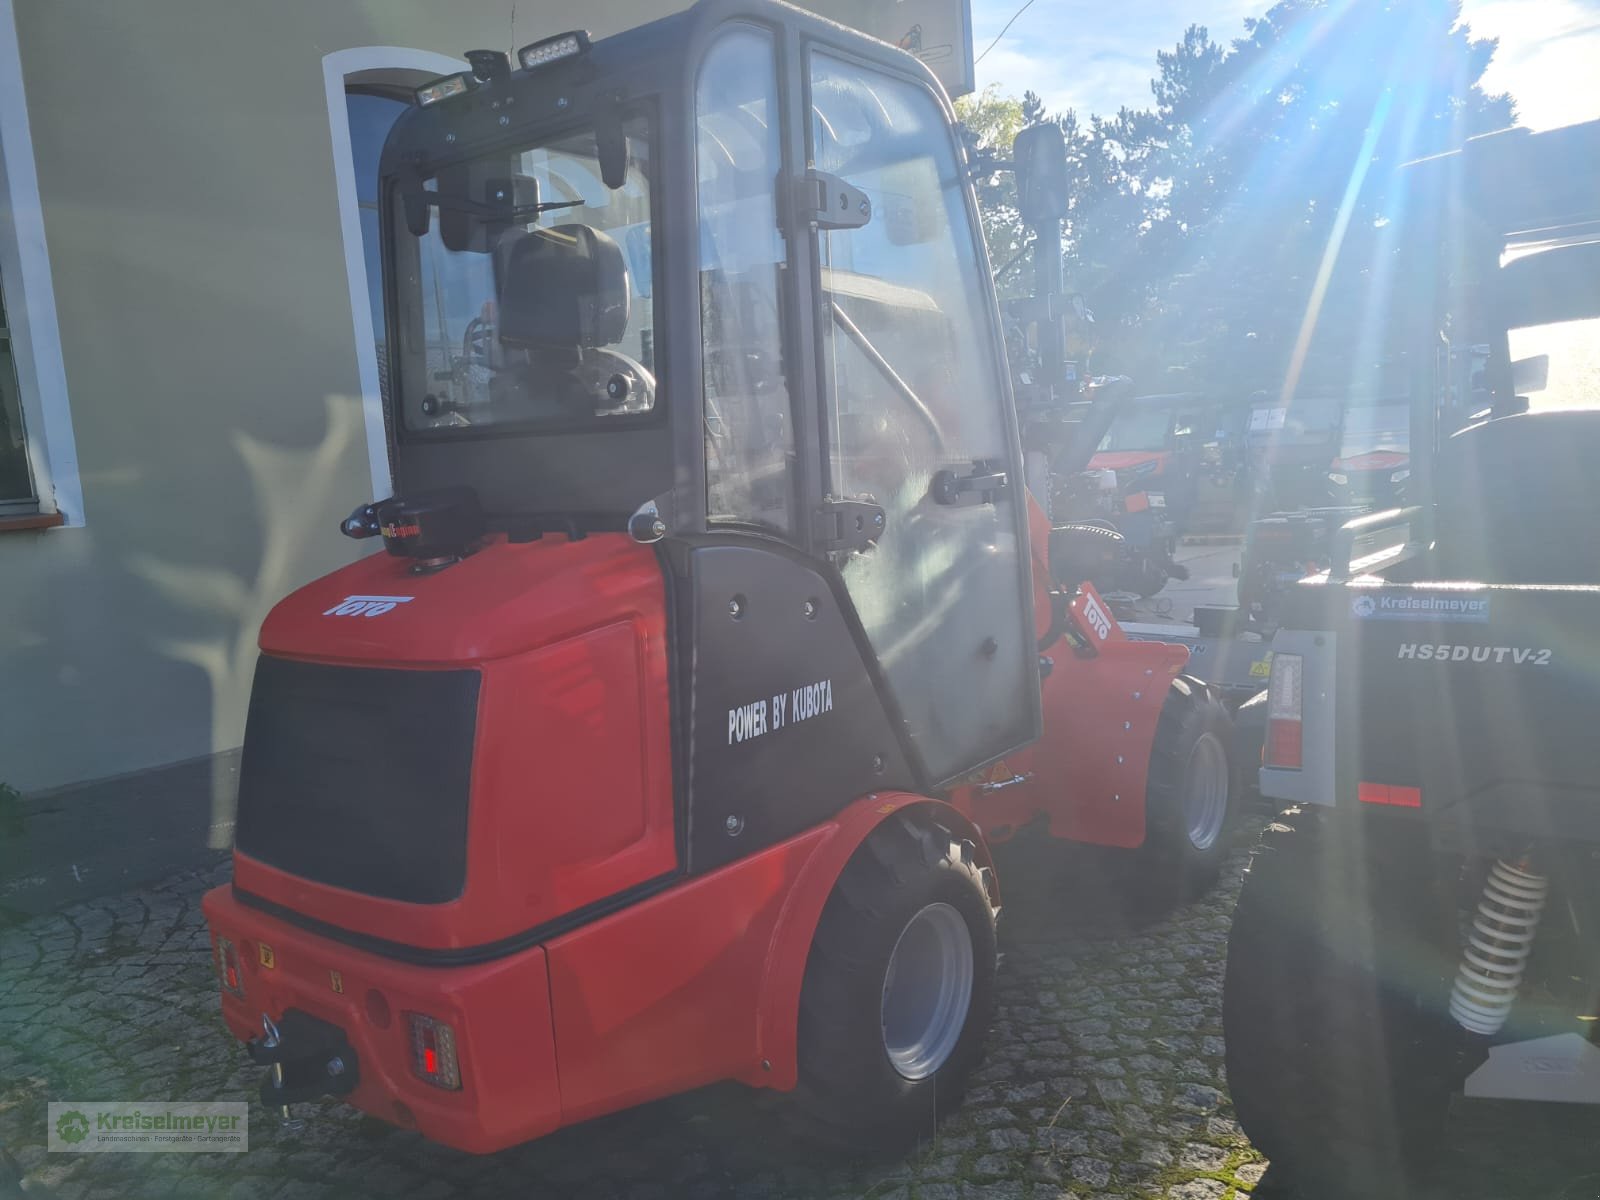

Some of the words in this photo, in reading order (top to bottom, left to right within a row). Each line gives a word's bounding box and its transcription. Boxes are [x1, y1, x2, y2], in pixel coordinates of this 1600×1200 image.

[1380, 596, 1487, 612] Kreiselmeyer
[1398, 644, 1552, 665] HS5DUTV-2
[728, 700, 767, 745] POWER
[773, 693, 787, 730] BY
[792, 679, 833, 723] KUBOTA
